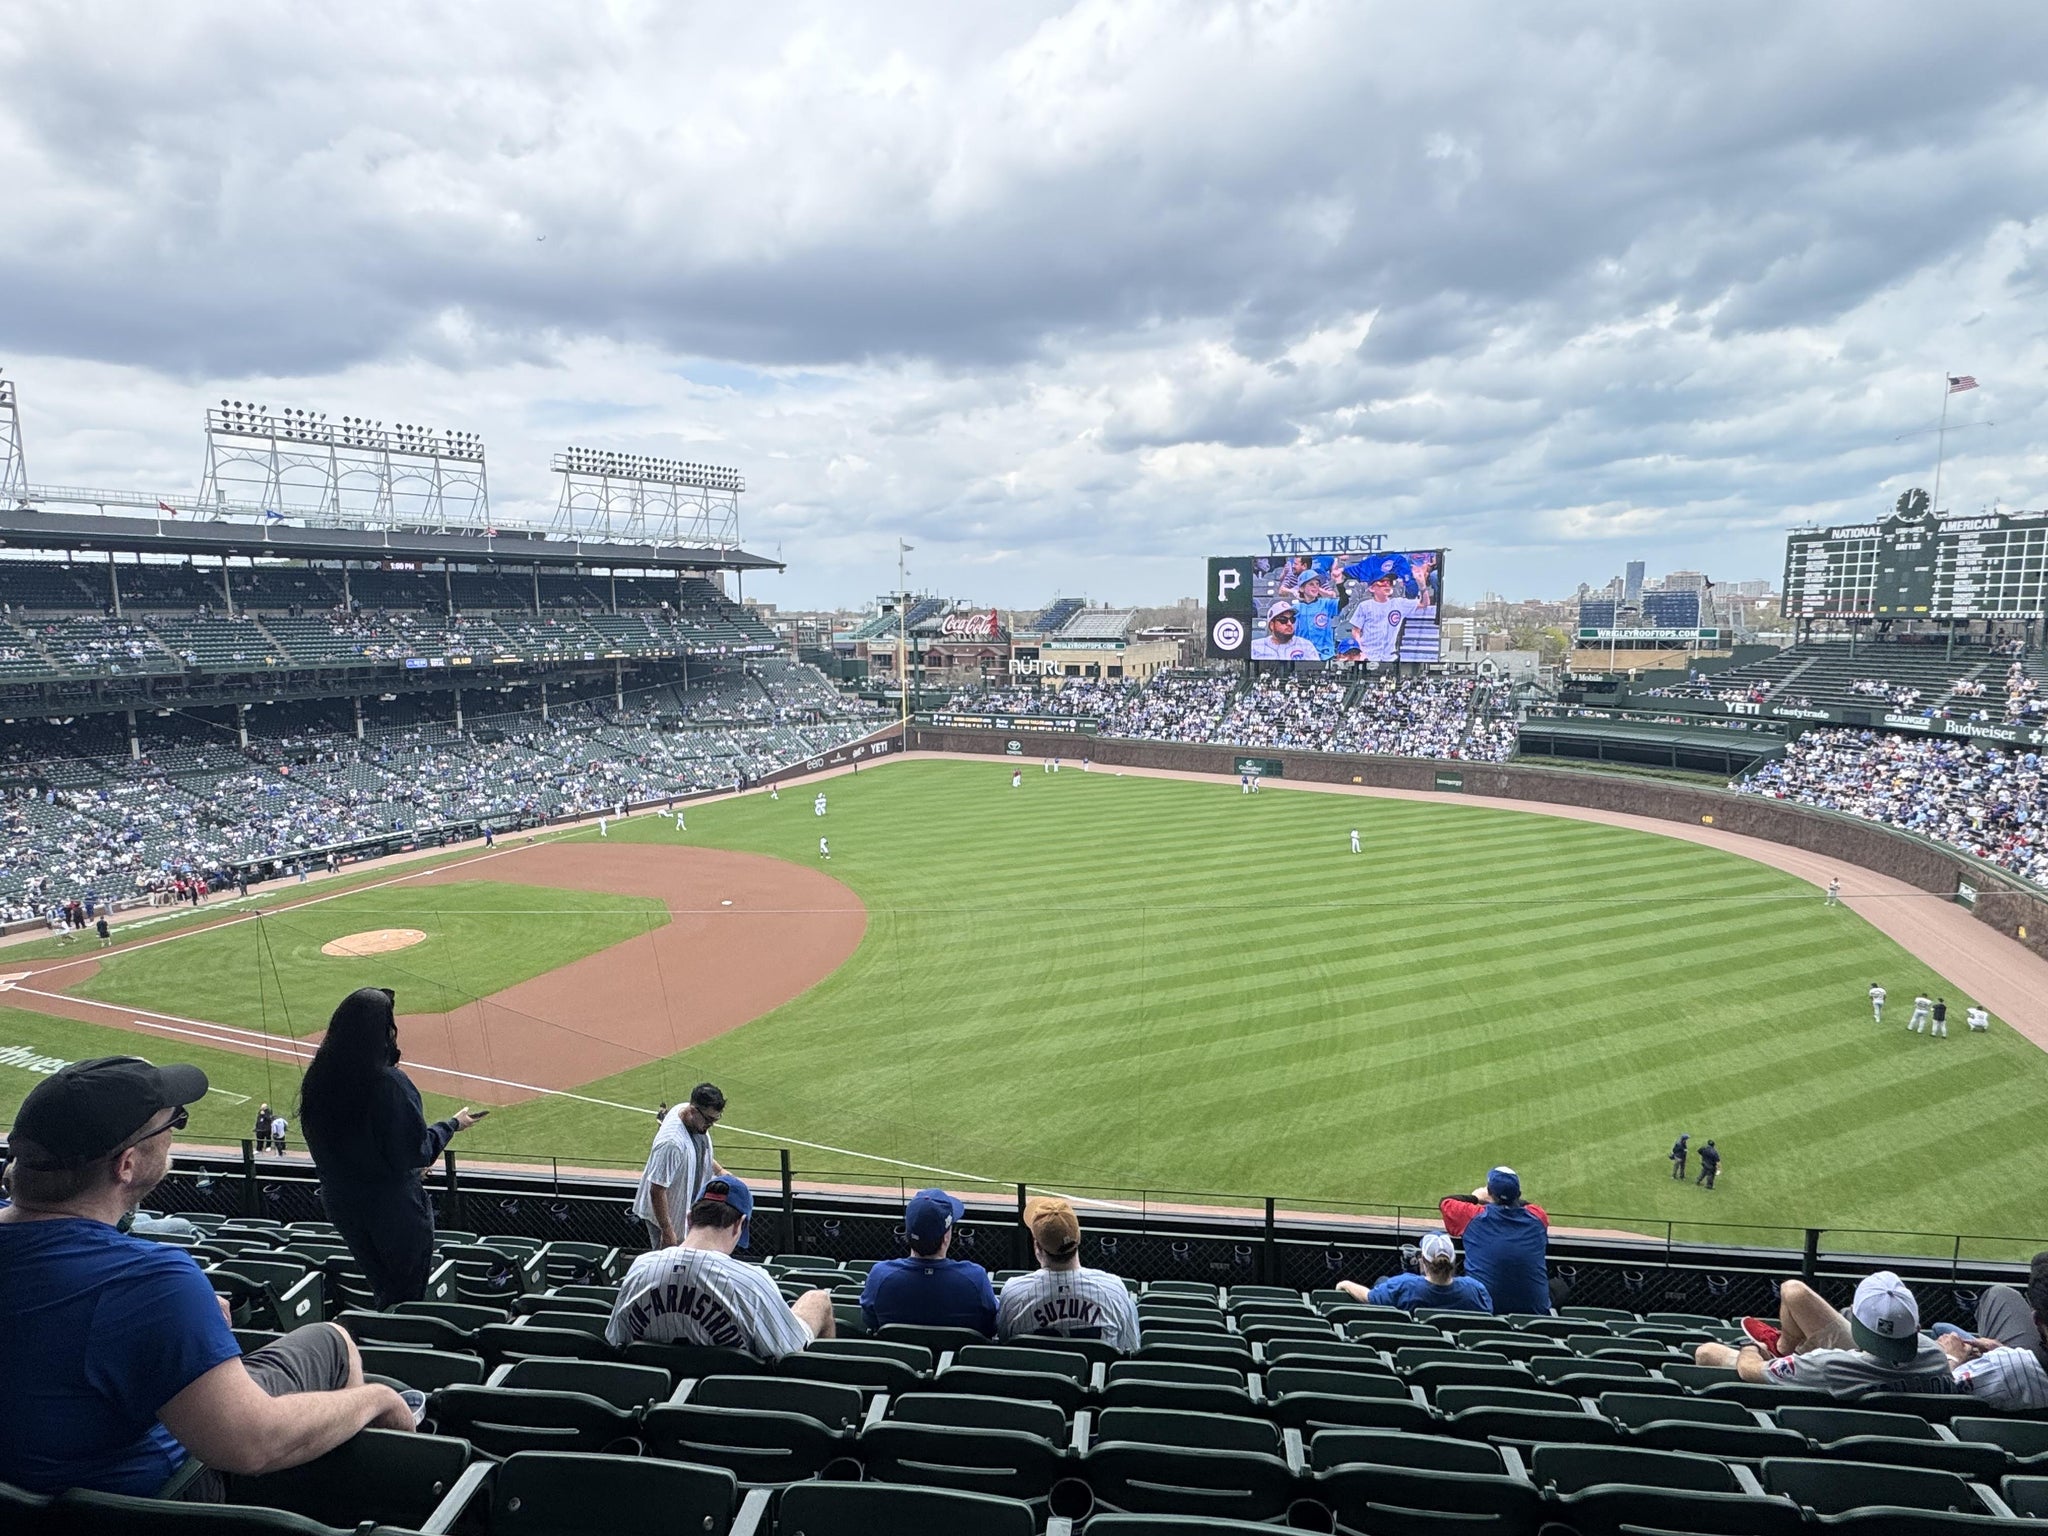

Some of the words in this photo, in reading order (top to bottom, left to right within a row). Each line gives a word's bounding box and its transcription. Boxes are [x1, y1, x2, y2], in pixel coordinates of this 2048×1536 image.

[1938, 518, 1999, 532] AMERICAN
[1832, 527, 1882, 539] NATIONAL
[1218, 569, 1240, 602] P
[1598, 629, 1698, 637] WRIGLEYROOFTOPS.COM
[1725, 702, 1760, 714] YETI
[1780, 708, 1830, 719] tastytrade
[1884, 714, 1930, 725] GRAINGER
[870, 741, 888, 754] YETI
[807, 758, 824, 770] eero
[1034, 1299, 1101, 1328] SUZUKI
